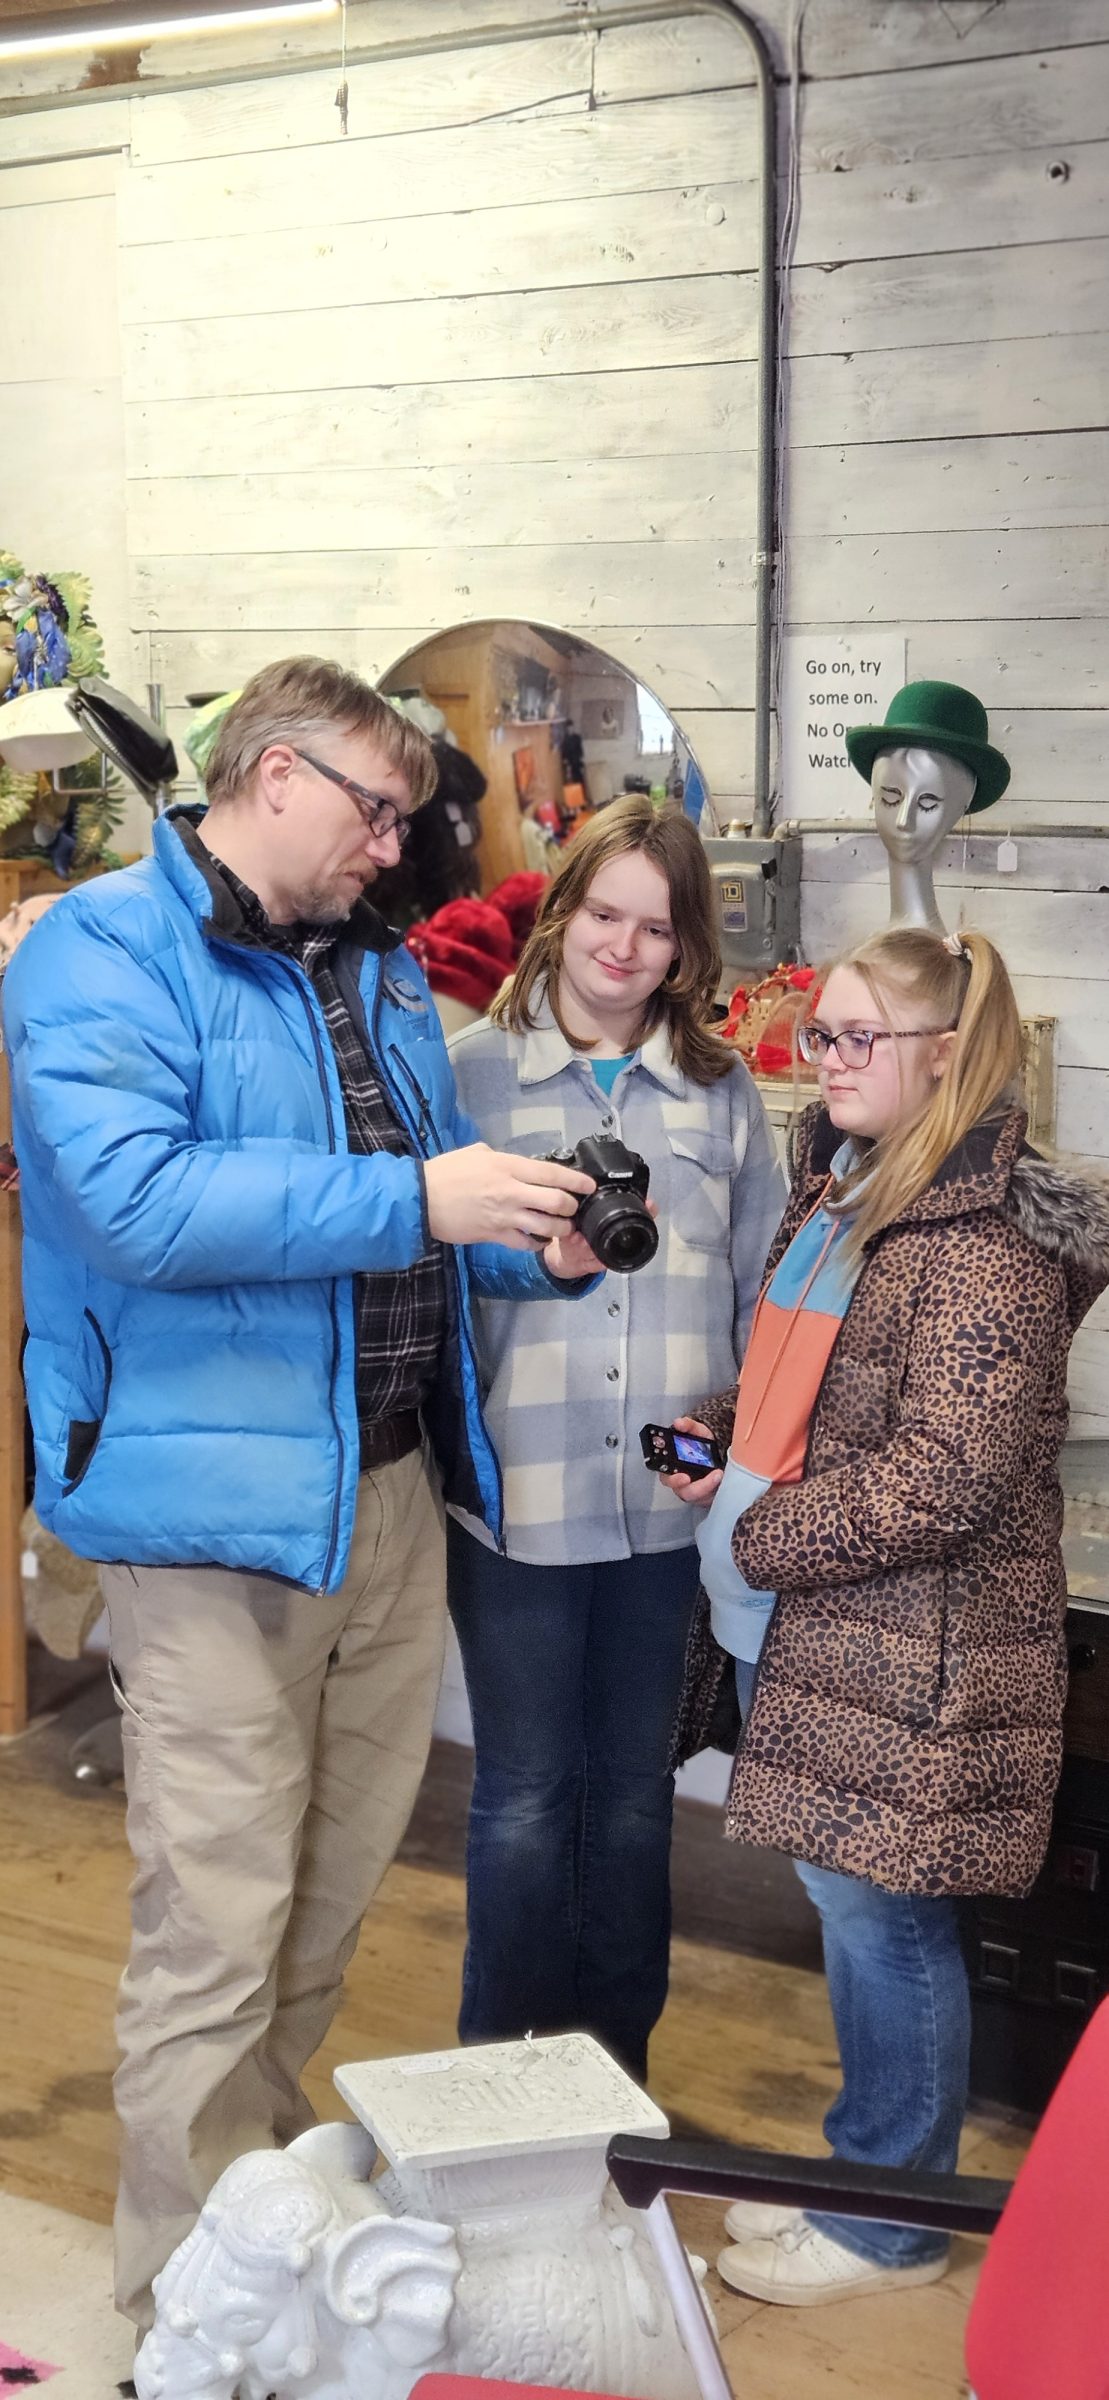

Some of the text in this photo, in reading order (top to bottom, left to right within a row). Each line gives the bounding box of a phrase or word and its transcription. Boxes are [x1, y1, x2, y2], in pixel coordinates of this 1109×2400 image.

[806, 659, 881, 676] Go on, try
[809, 692, 877, 706] some on.
[807, 723, 828, 737] No
[808, 754, 851, 769] Watc
